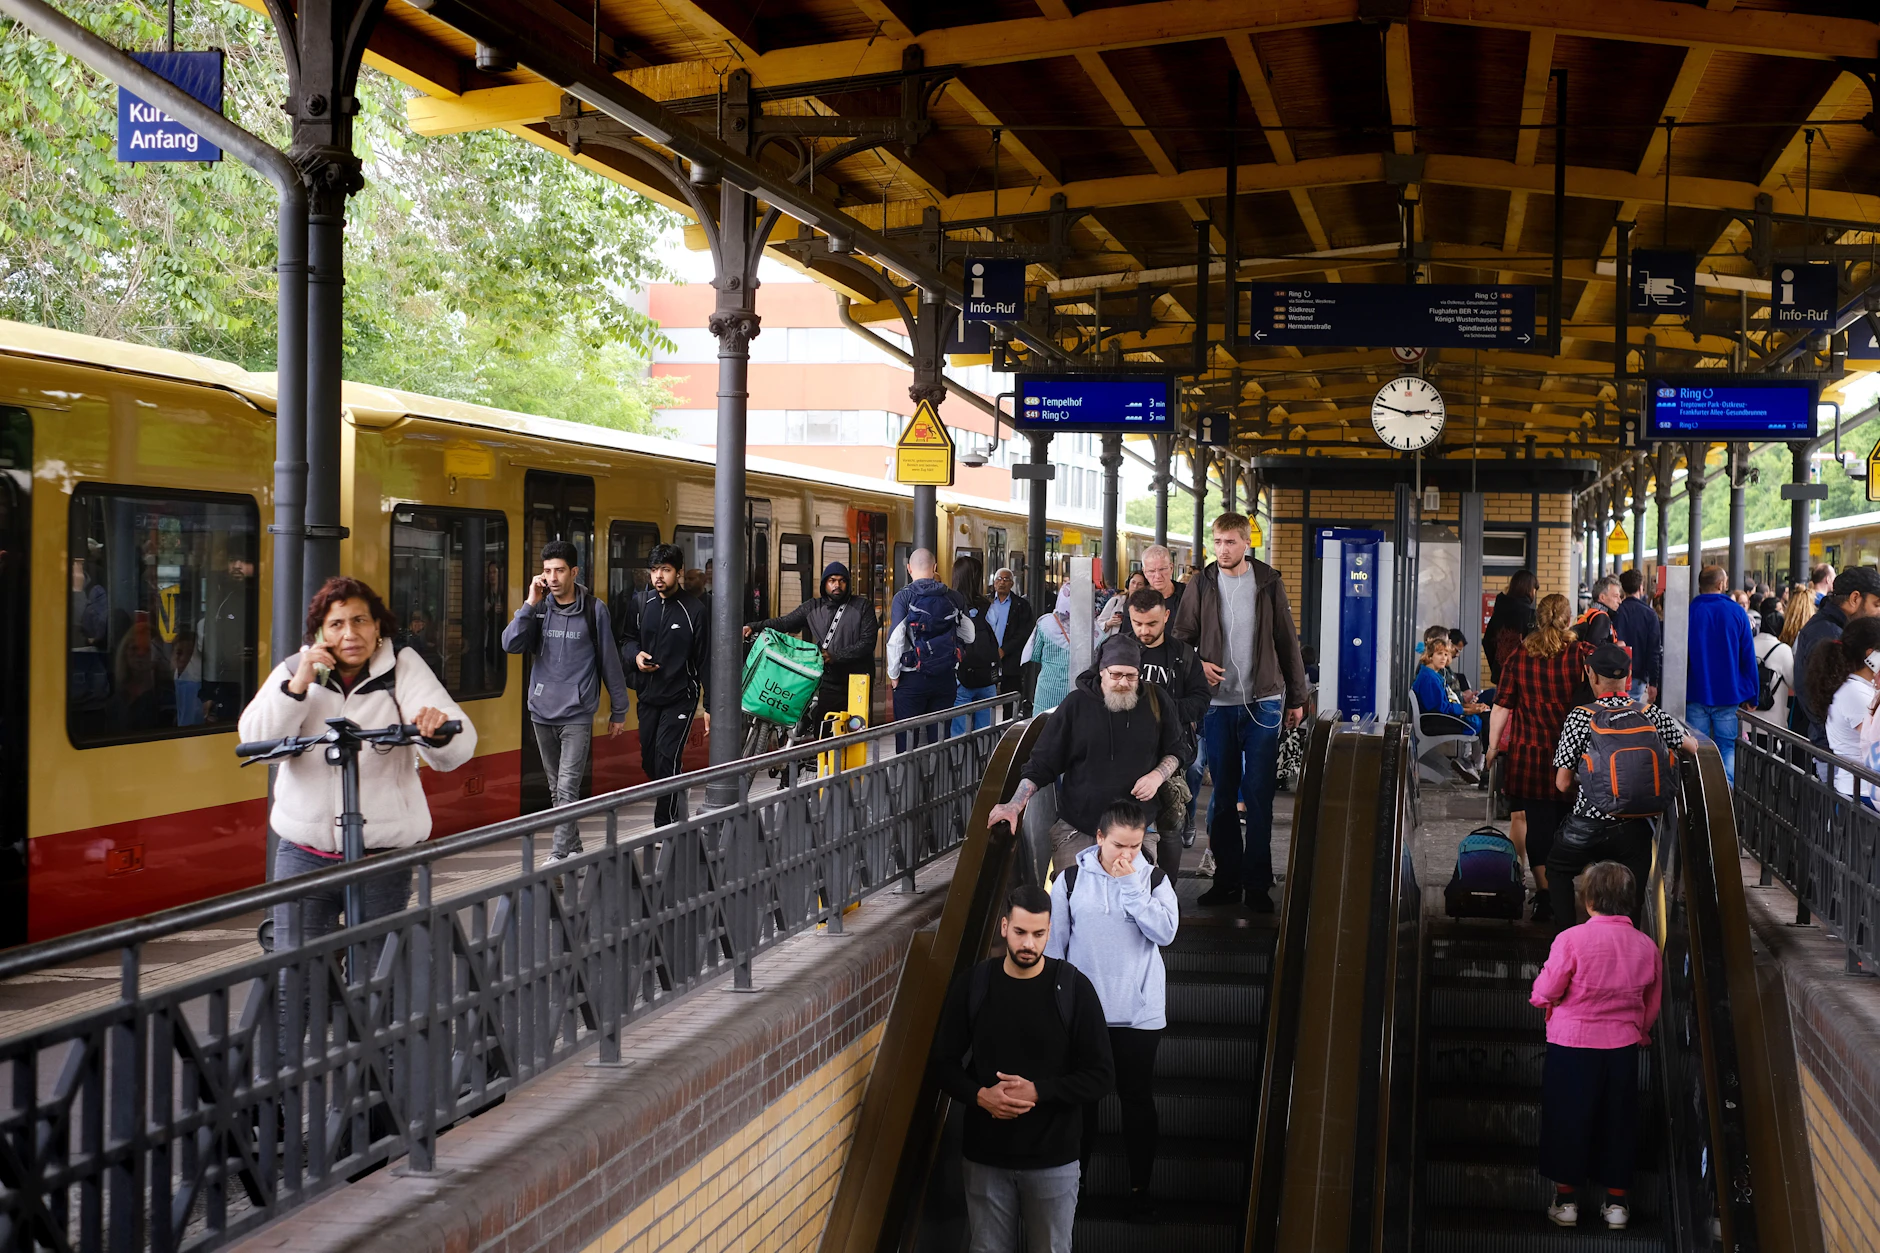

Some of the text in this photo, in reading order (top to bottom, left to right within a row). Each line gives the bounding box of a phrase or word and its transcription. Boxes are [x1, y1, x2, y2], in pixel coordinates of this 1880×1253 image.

[129, 103, 178, 122] Kurz
[129, 129, 198, 152] Anfang
[970, 302, 1016, 313] Info-Ruf
[1780, 309, 1829, 321] Info-Ruf
[1658, 388, 1701, 401] S42 Ring
[1025, 397, 1039, 405] S45
[1042, 397, 1083, 408] Tempelhof
[1149, 398, 1155, 408] 3
[1680, 401, 1707, 409] Treptower
[1025, 410, 1039, 418] S41
[1042, 410, 1060, 421] Ring
[1149, 412, 1155, 421] 5
[1679, 422, 1692, 430] Ring
[1351, 570, 1368, 580] Info
[764, 677, 797, 701] Uber
[758, 689, 790, 713] Eats
